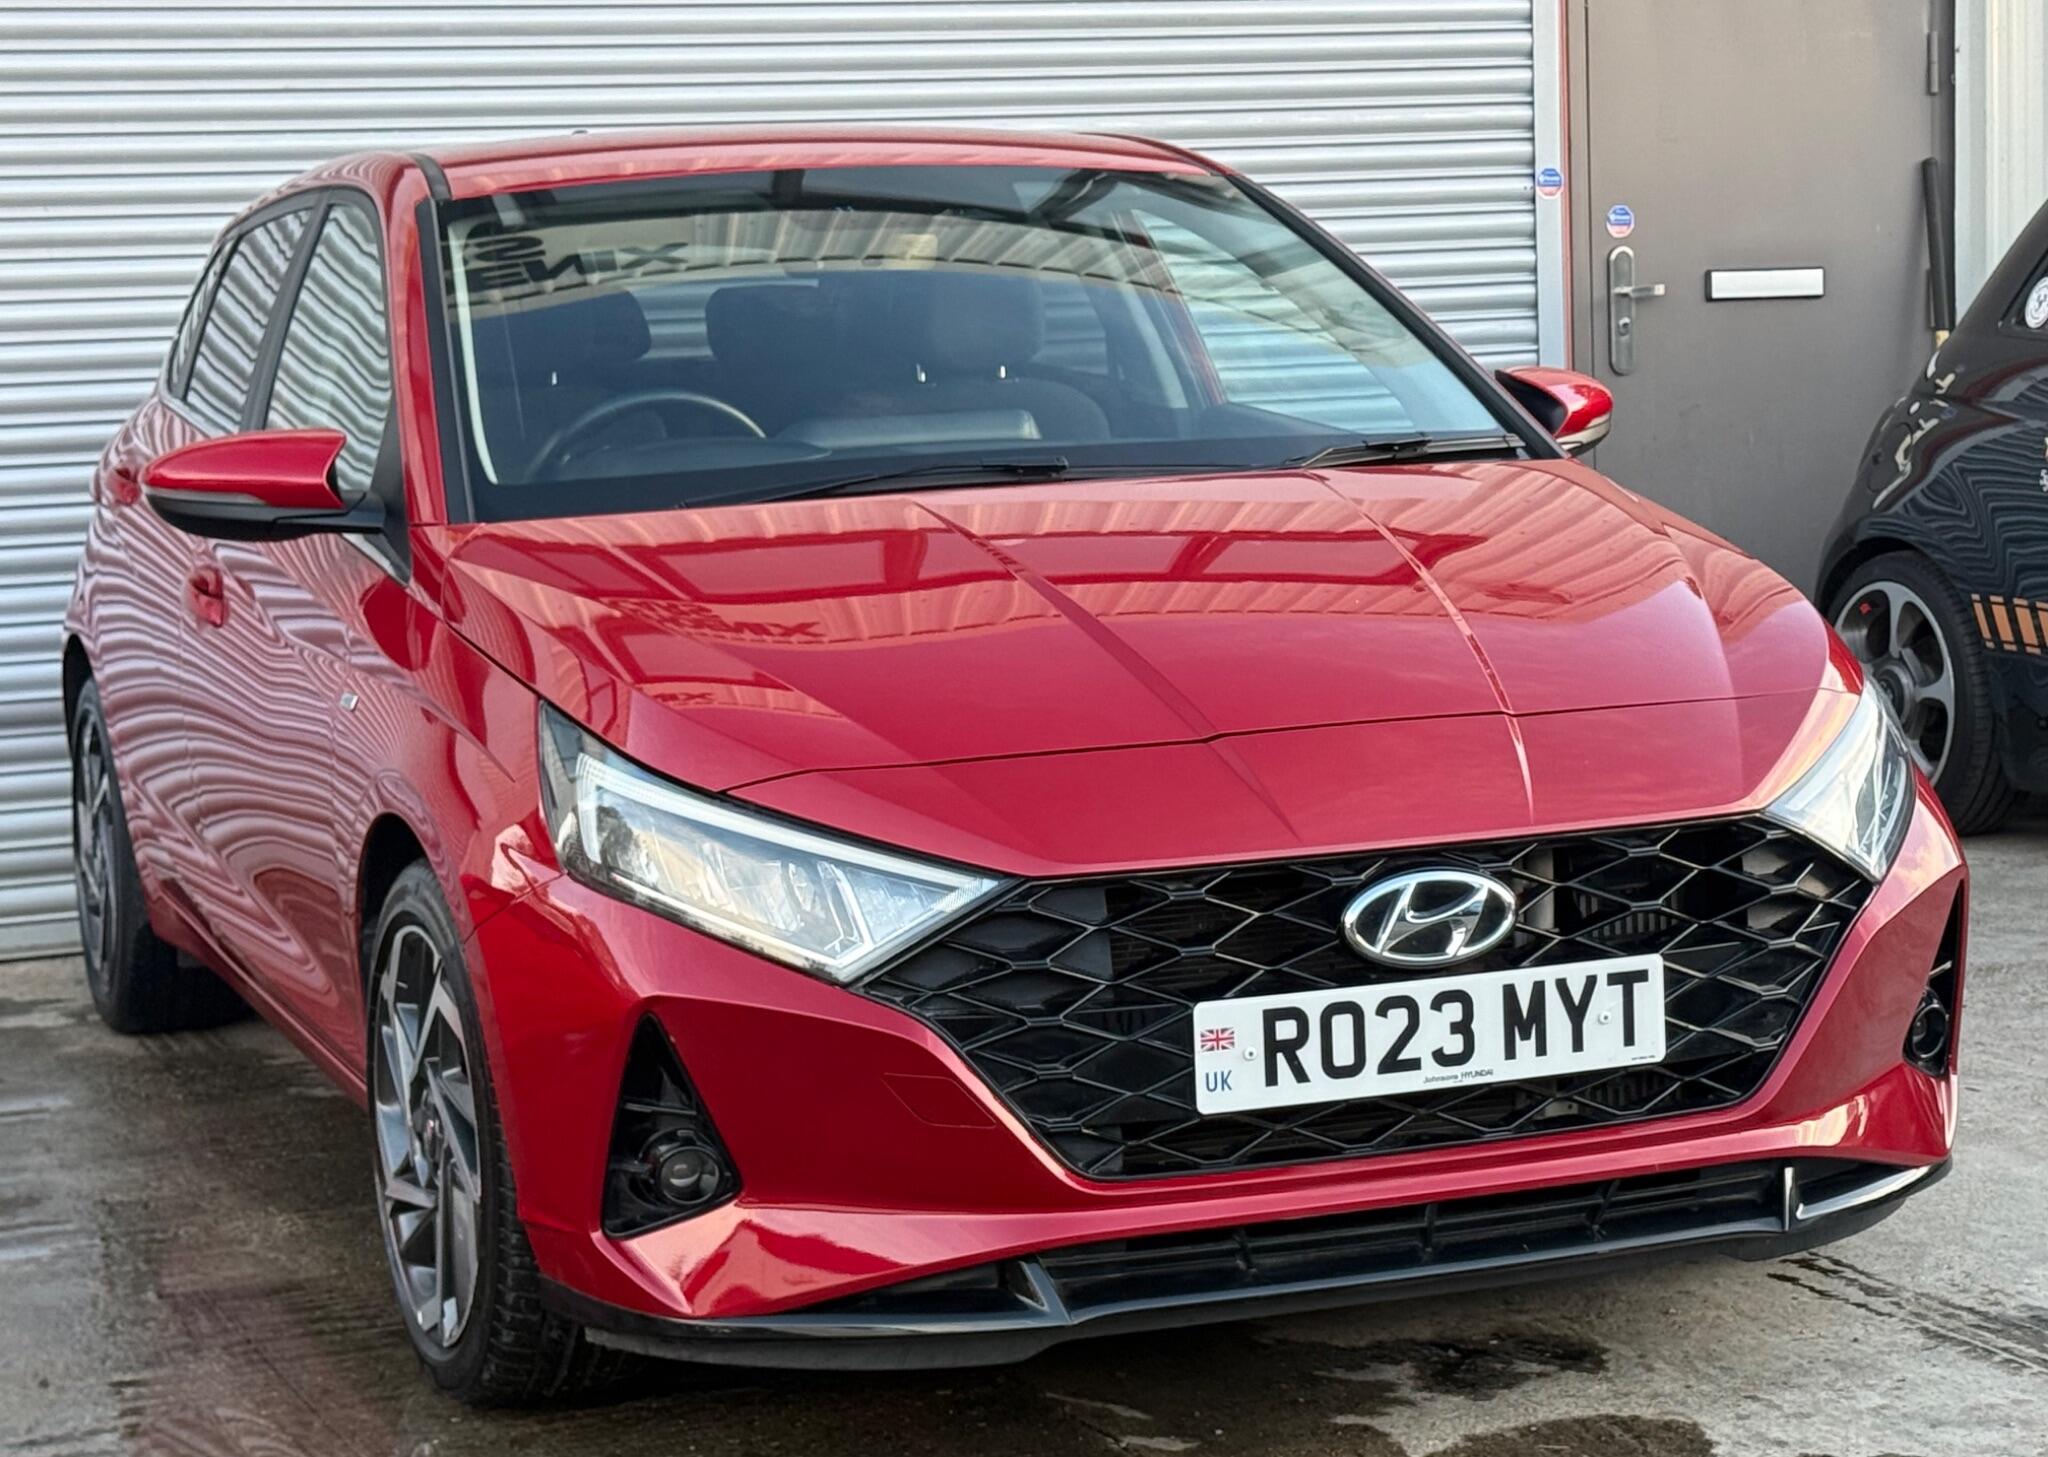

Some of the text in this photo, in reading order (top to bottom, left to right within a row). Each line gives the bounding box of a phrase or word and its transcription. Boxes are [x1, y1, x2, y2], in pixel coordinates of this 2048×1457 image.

[1262, 968, 1650, 1087] RO23 MYT
[1205, 1069, 1232, 1093] UK
[1461, 1069, 1494, 1079] HYUNDAI
